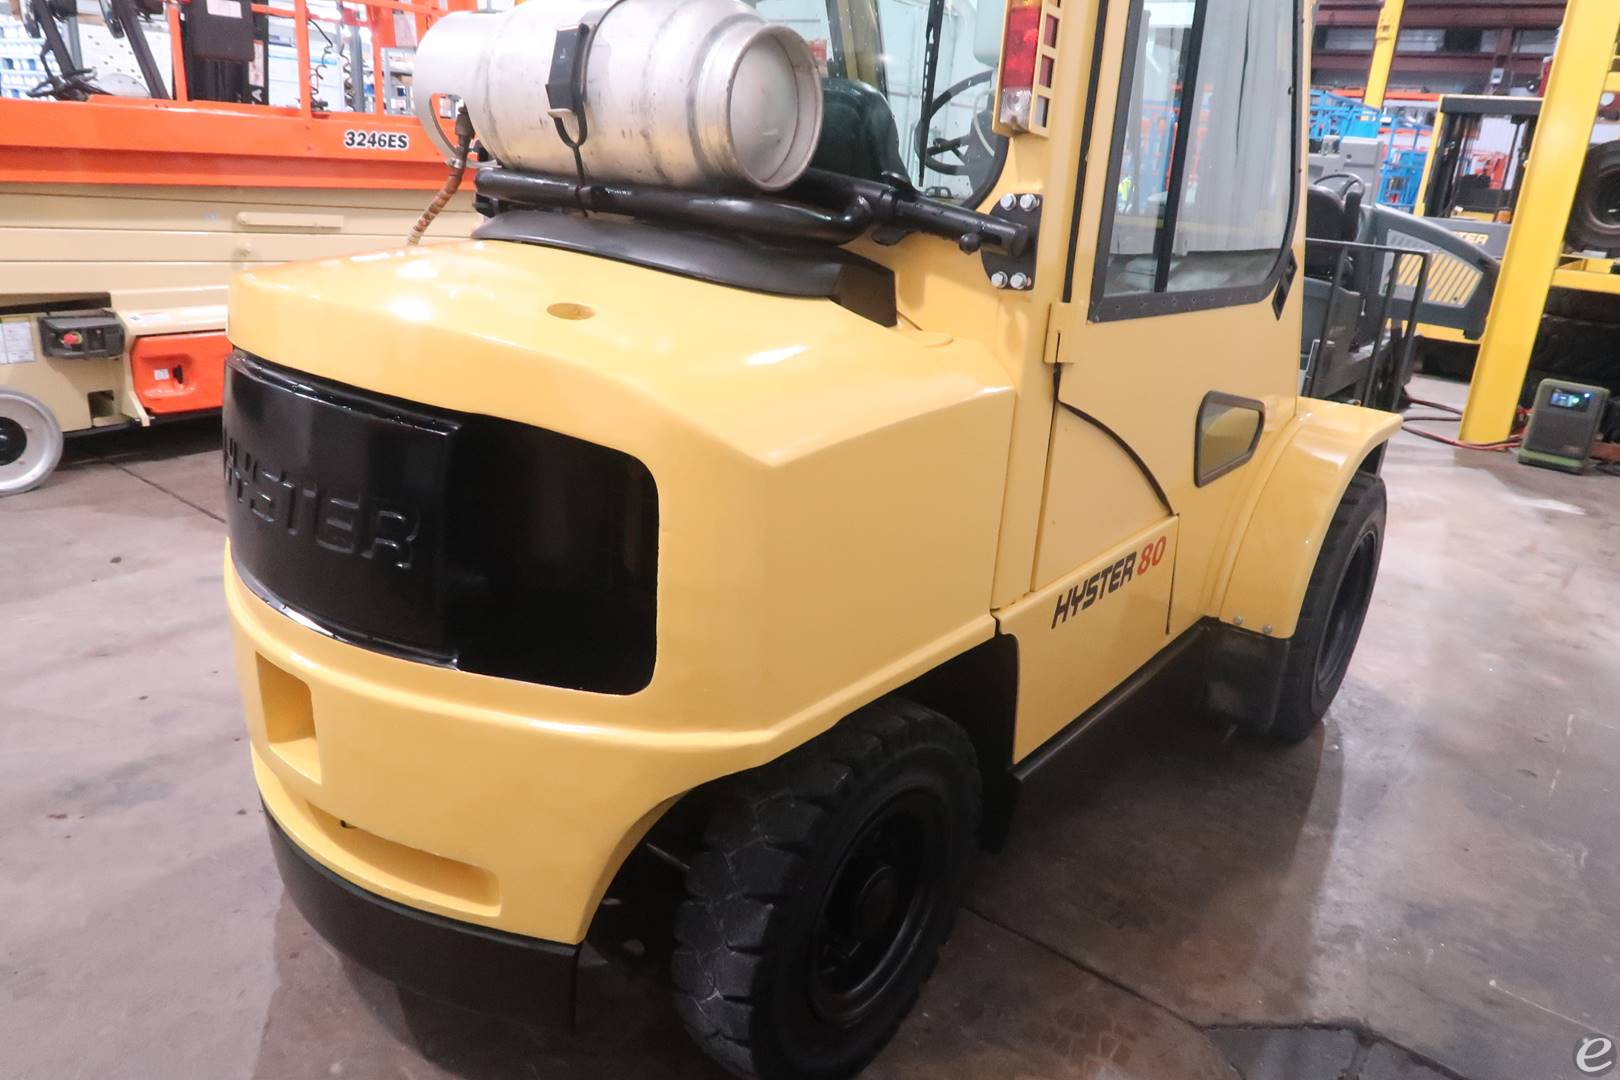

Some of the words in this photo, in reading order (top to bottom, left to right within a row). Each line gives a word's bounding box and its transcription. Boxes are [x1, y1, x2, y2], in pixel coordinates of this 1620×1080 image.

[344, 131, 408, 149] 3246ES
[1051, 551, 1137, 630] HYSTER
[1136, 535, 1167, 576] 80
